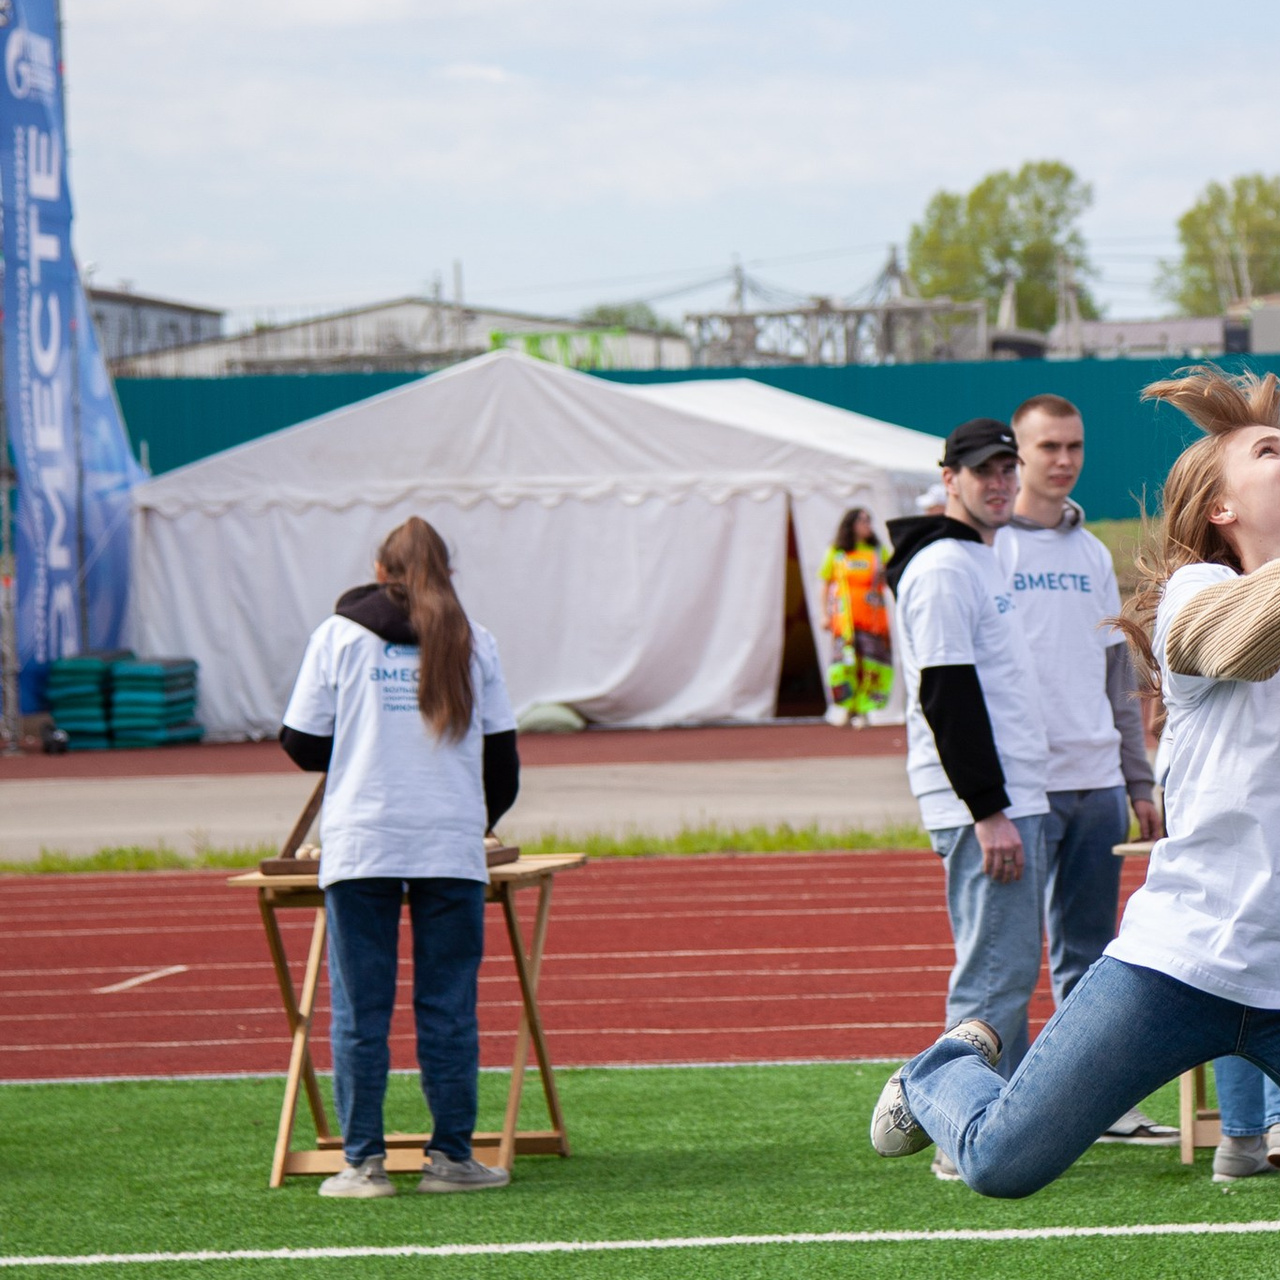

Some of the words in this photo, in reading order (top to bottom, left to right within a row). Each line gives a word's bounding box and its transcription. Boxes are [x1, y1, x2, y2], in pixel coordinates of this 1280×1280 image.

[26, 124, 78, 662] ВМЕСТЕ
[1013, 572, 1092, 593] ВМЕСТЕ
[369, 667, 421, 682] ВМЕС
